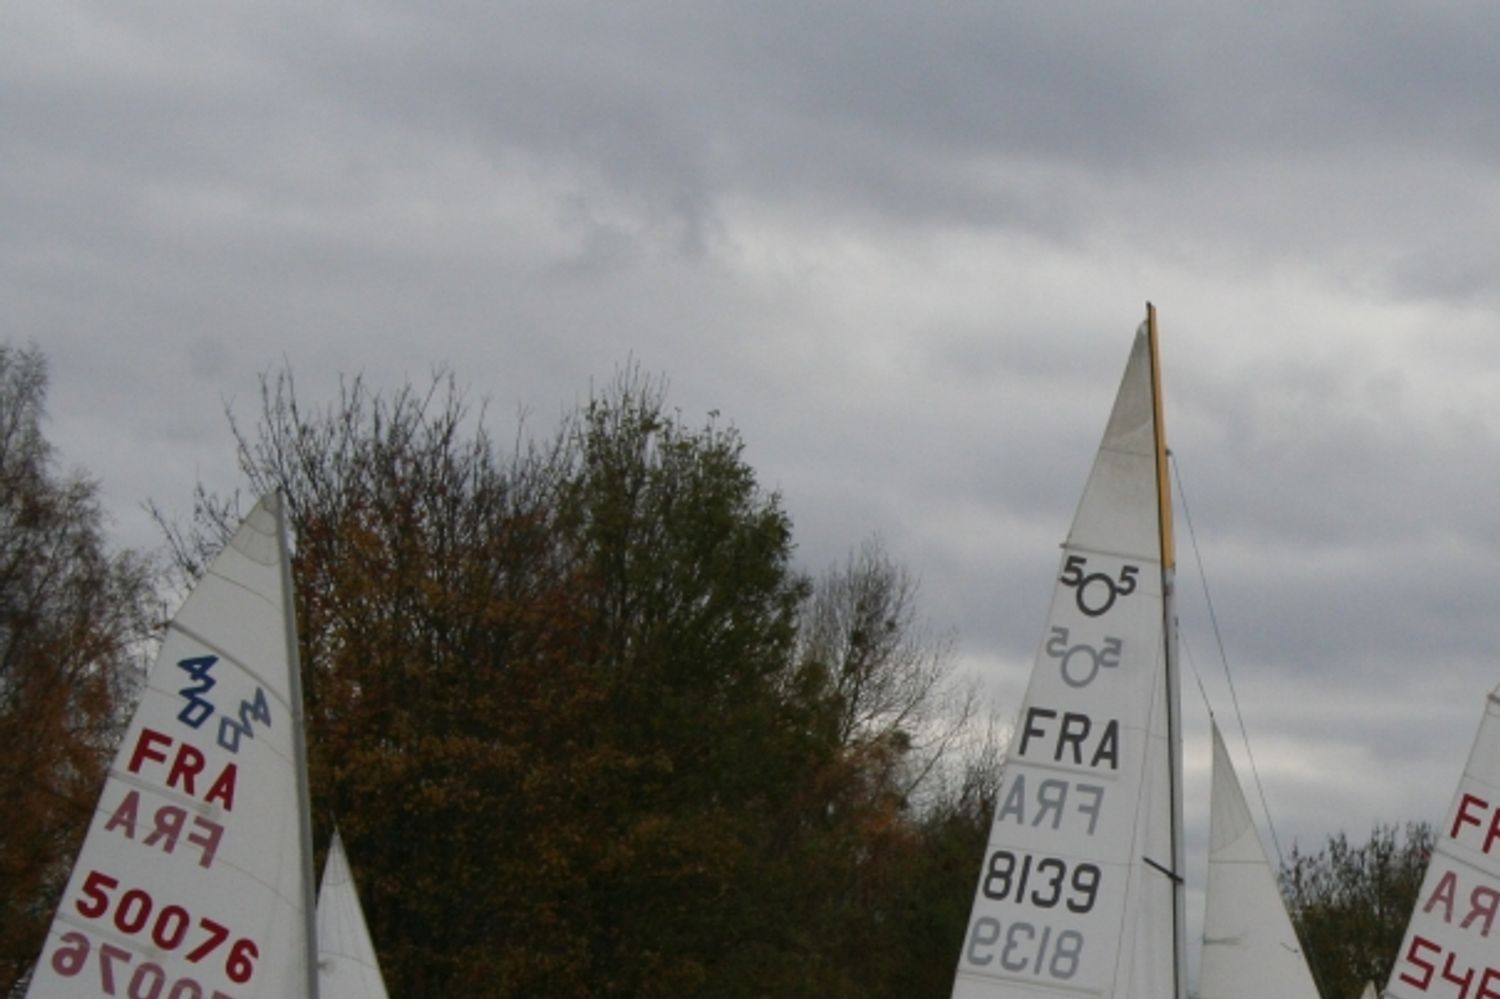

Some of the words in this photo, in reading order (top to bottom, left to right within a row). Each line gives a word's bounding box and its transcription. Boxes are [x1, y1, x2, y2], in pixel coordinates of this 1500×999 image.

[1060, 555, 1139, 616] 505
[127, 728, 237, 811] FRA
[1018, 707, 1119, 769] FRA
[982, 850, 1101, 913] 8139
[75, 870, 259, 984] 50076
